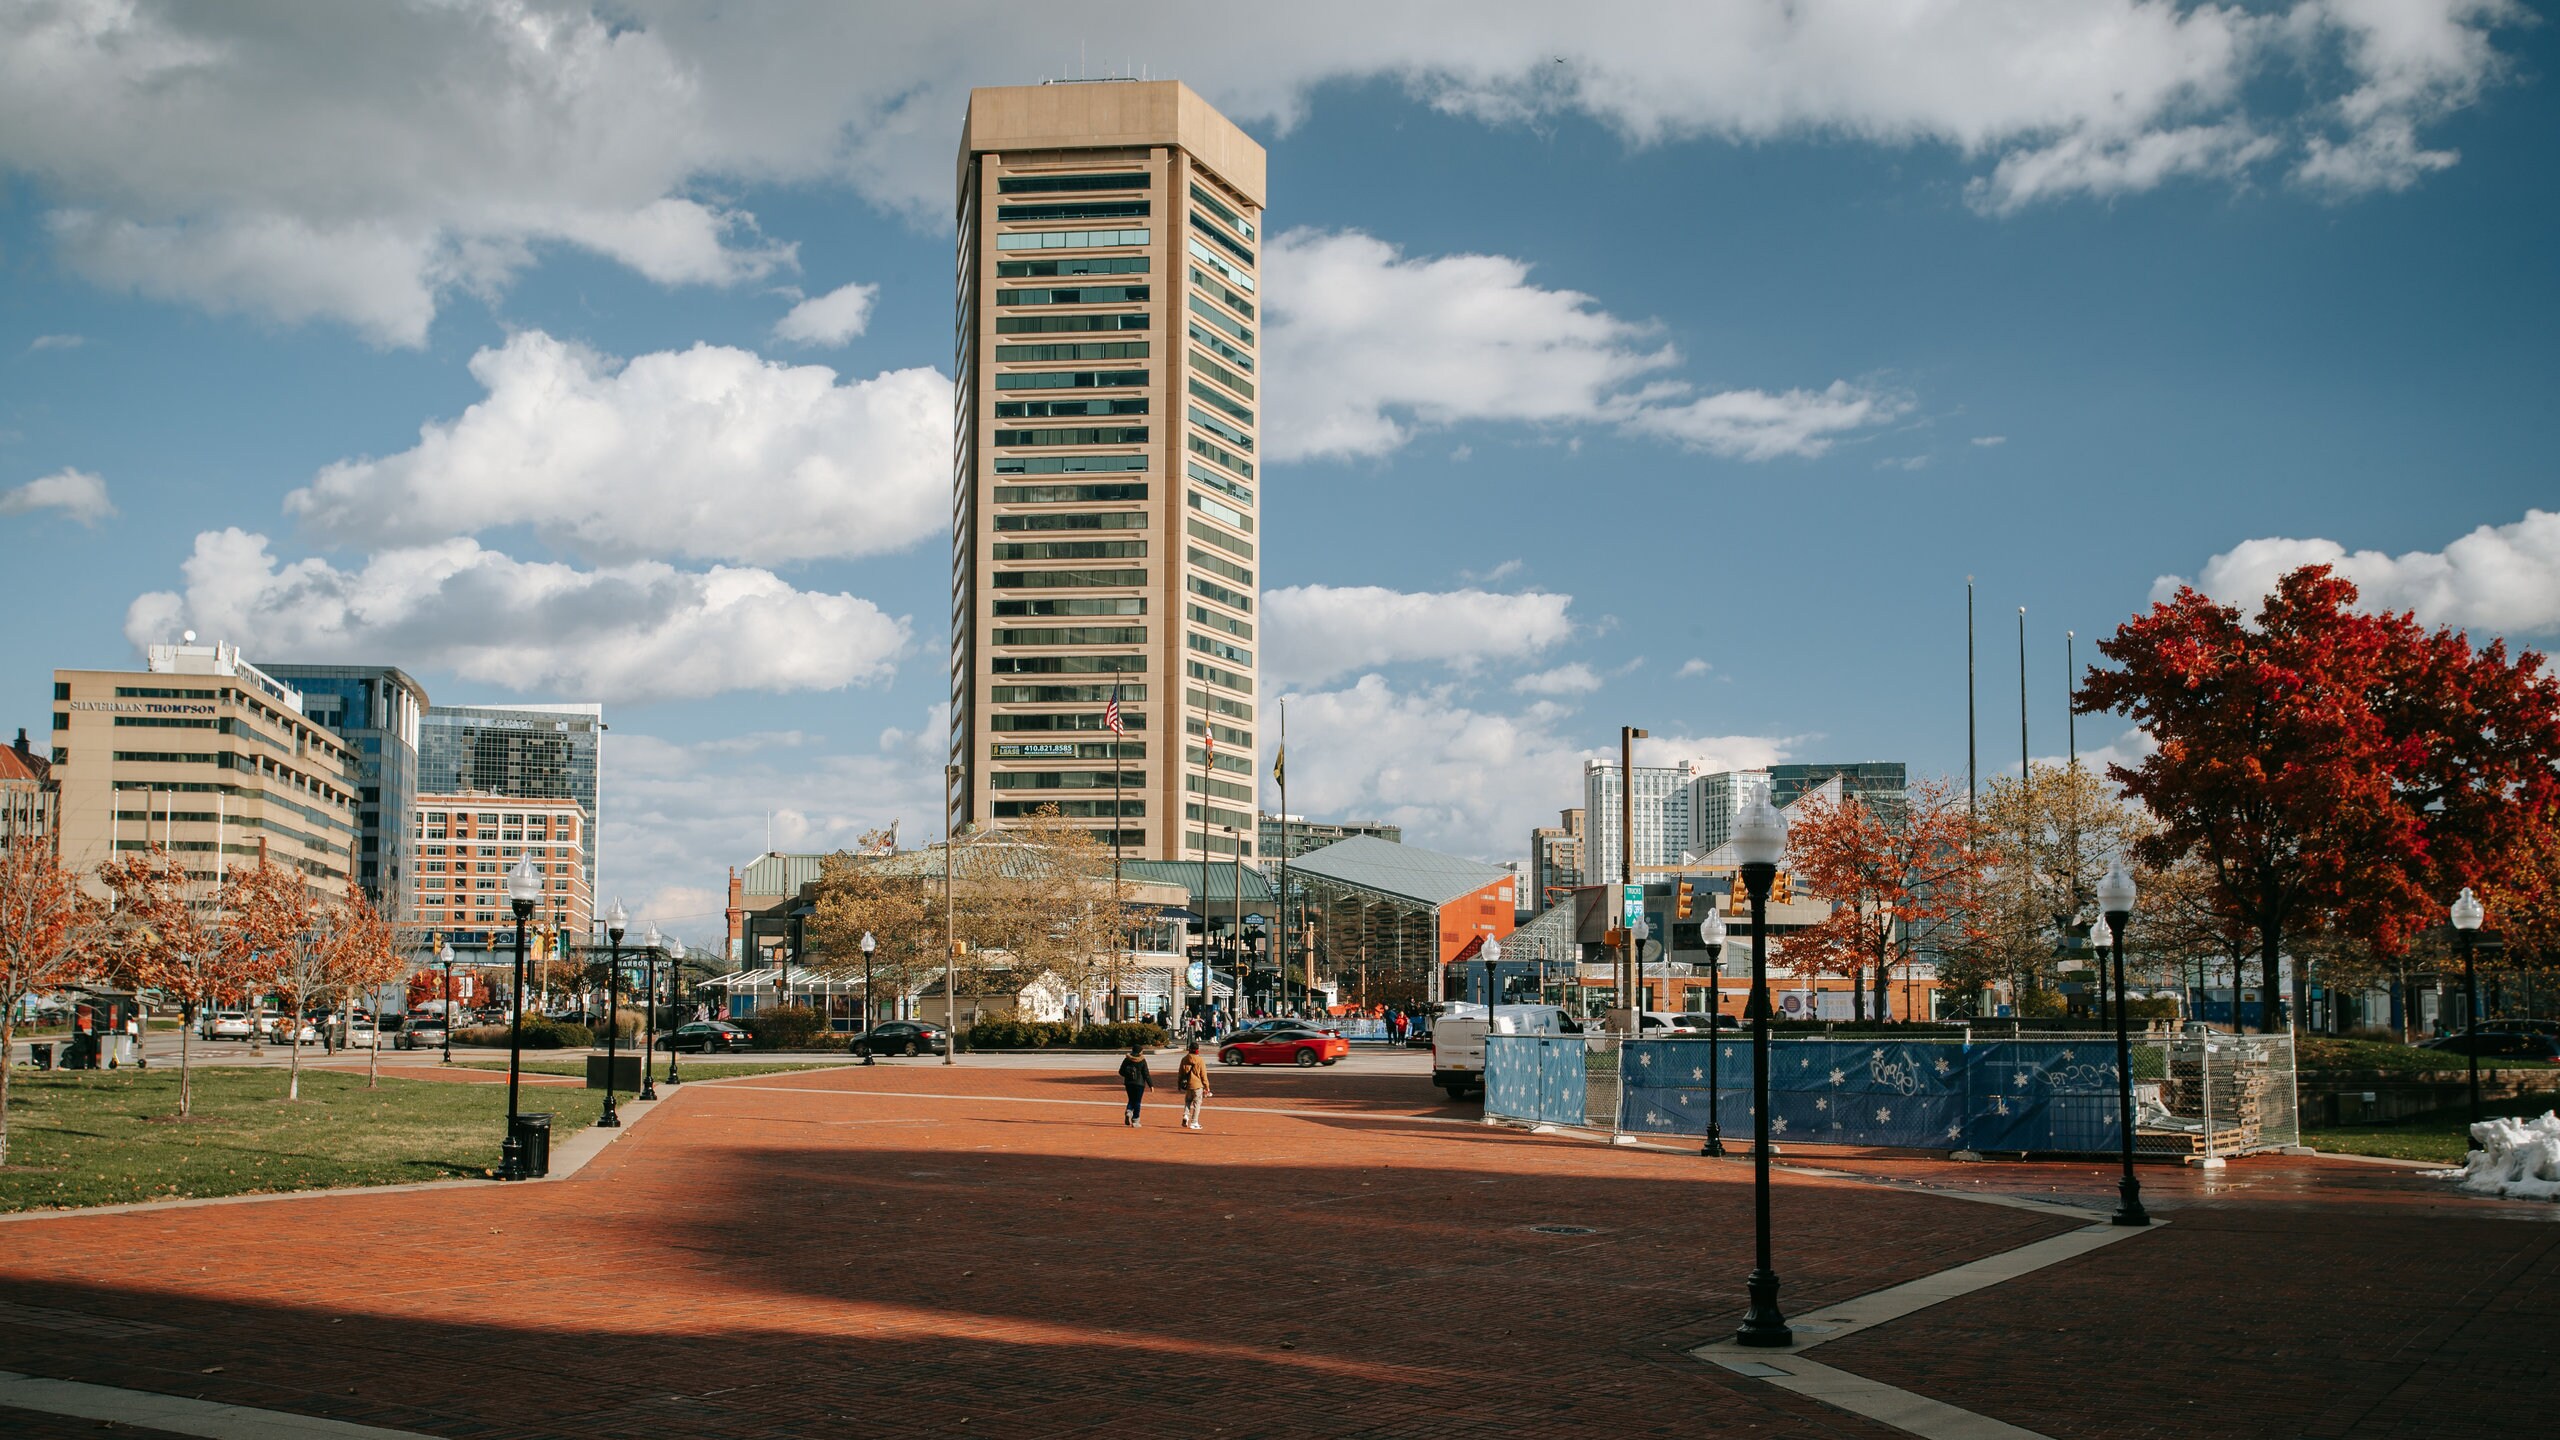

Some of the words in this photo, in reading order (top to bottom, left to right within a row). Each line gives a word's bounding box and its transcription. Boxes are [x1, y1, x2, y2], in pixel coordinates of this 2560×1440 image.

[70, 701, 143, 713] SILVERMAN
[145, 704, 216, 715] THOMPSON
[1626, 887, 1641, 895] TRUCKS
